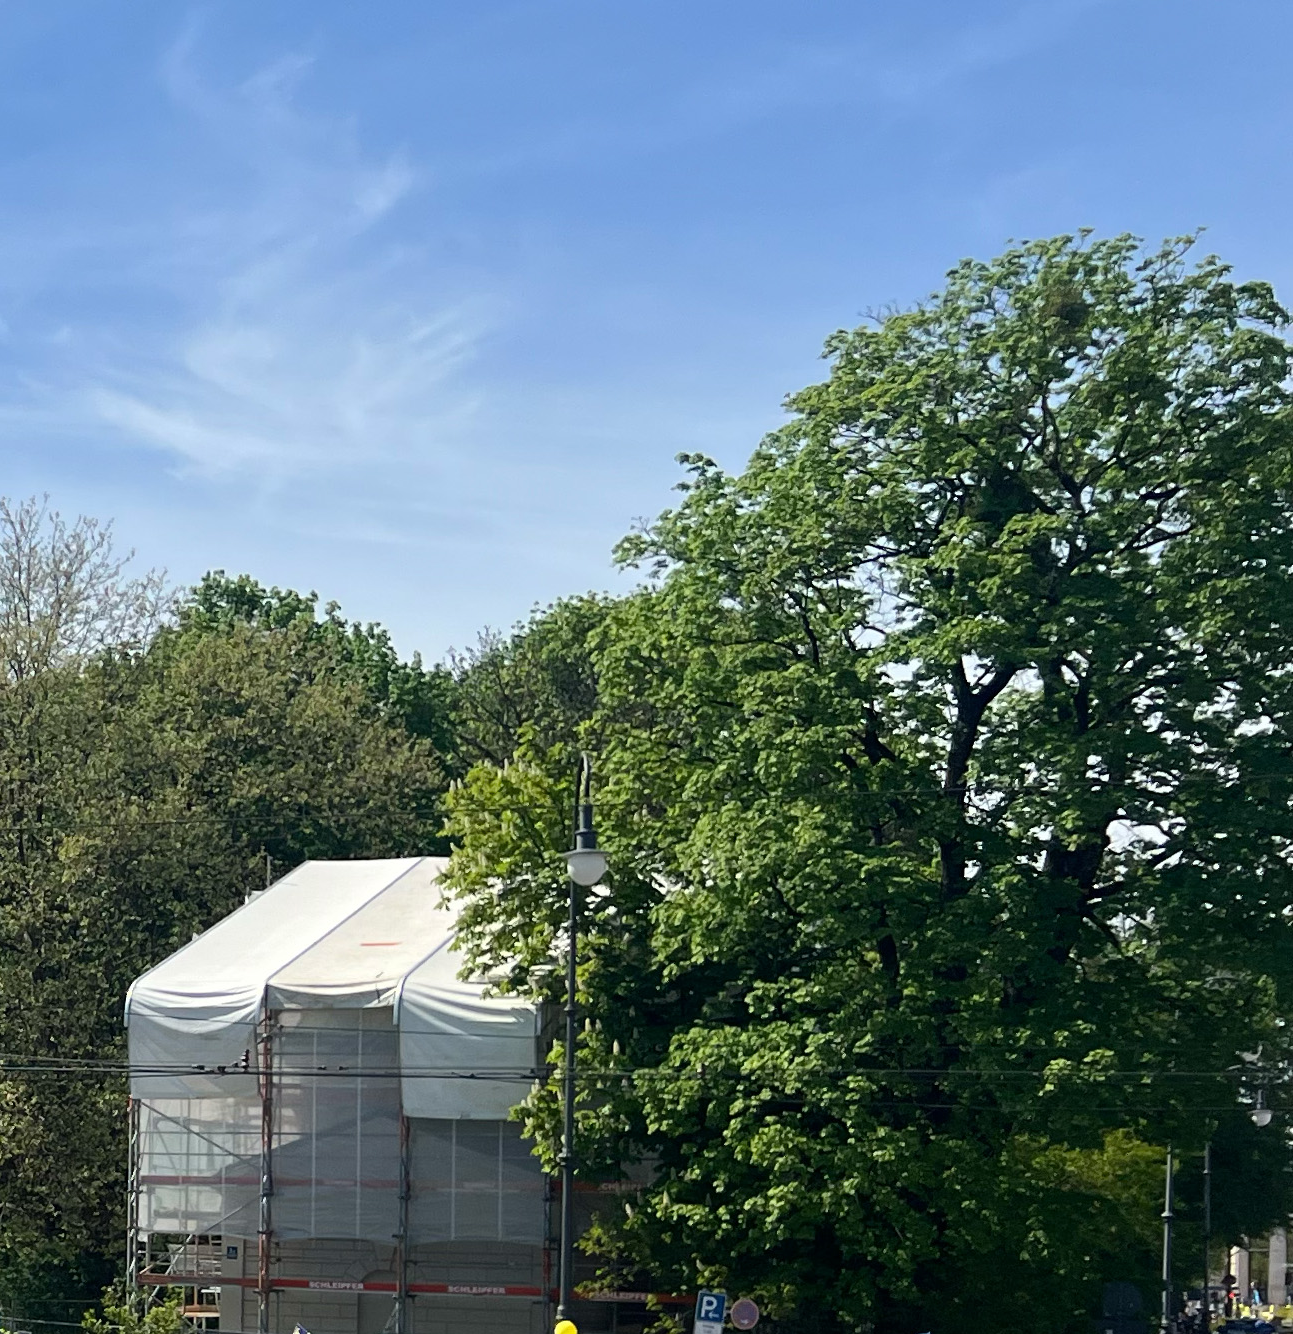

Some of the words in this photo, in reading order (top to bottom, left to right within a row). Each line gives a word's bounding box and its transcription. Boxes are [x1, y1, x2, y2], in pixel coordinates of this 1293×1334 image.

[309, 1281, 364, 1290] SCHLEIPFER
[447, 1285, 506, 1294] SCHLEIPFER
[700, 1296, 718, 1318] P
